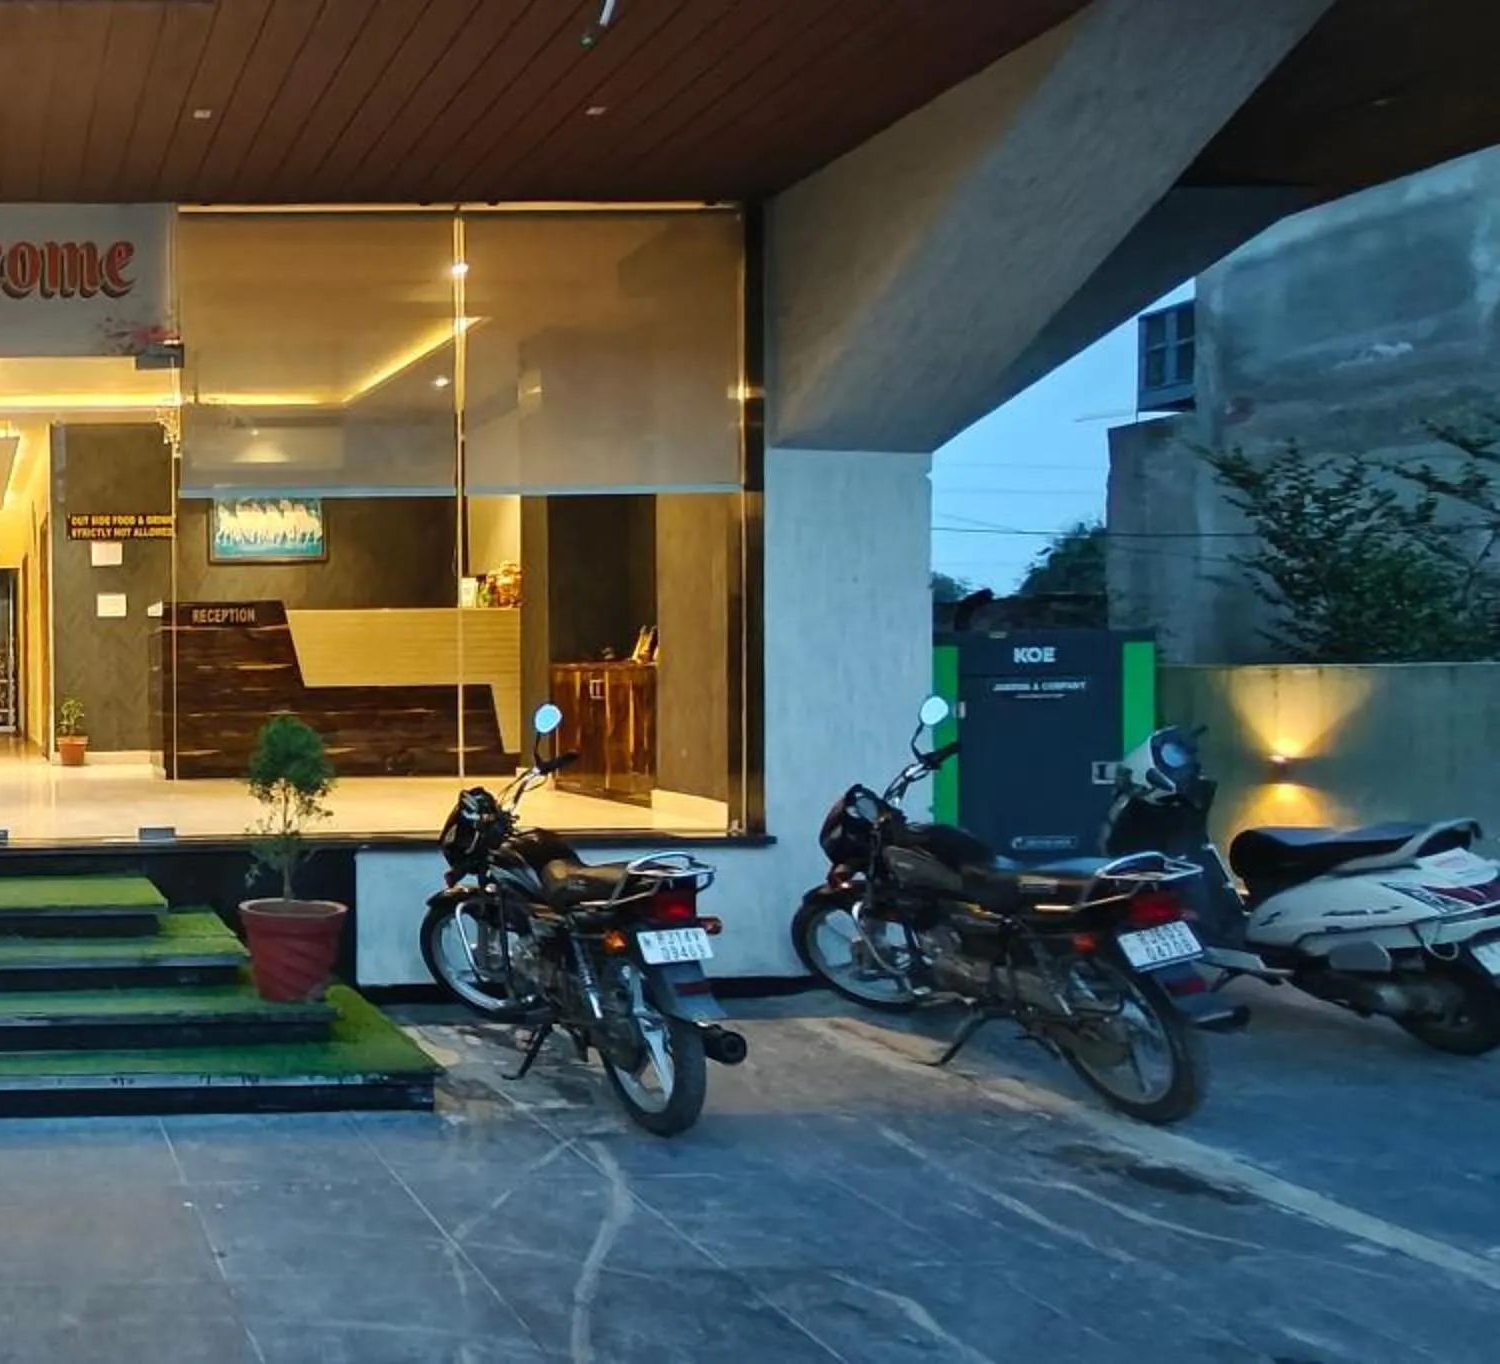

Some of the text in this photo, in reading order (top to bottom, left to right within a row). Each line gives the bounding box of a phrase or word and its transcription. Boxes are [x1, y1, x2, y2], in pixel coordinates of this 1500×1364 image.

[71, 515, 89, 526] OUT
[91, 515, 111, 526] SIDE
[112, 515, 136, 526] FOOD
[137, 515, 145, 525] &
[71, 527, 112, 538] STRICTLY
[113, 527, 132, 538] NOT
[191, 607, 255, 624] RECEPTION
[1013, 646, 1056, 663] KOE
